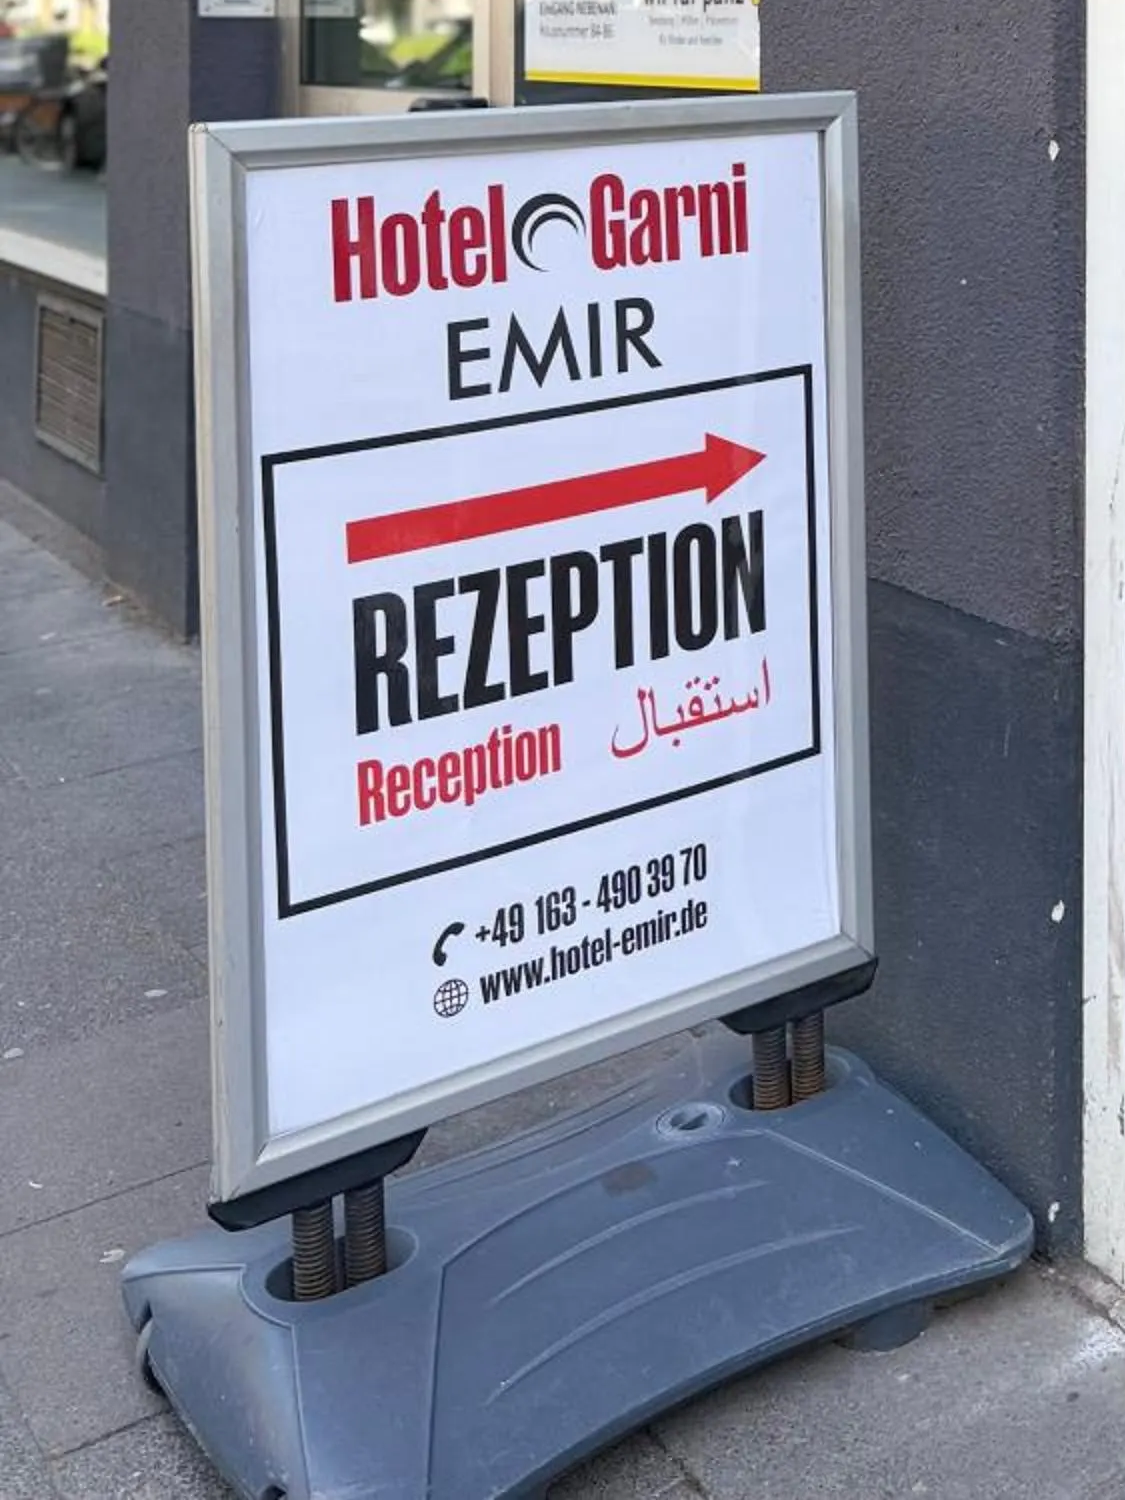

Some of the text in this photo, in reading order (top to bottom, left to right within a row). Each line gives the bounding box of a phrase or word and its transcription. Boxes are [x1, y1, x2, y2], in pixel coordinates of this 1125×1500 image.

[331, 163, 749, 302] Hotel Garni
[446, 296, 662, 400] EMIR
[351, 510, 767, 736] REZEPTION
[610, 657, 770, 759] استقبال
[357, 723, 562, 827] Reception
[475, 903, 525, 947] +49
[535, 886, 577, 935] 163
[596, 865, 641, 913] 490
[646, 853, 675, 897] 39
[680, 843, 707, 886] 70
[479, 899, 708, 1004] www.hotel-emir.de
